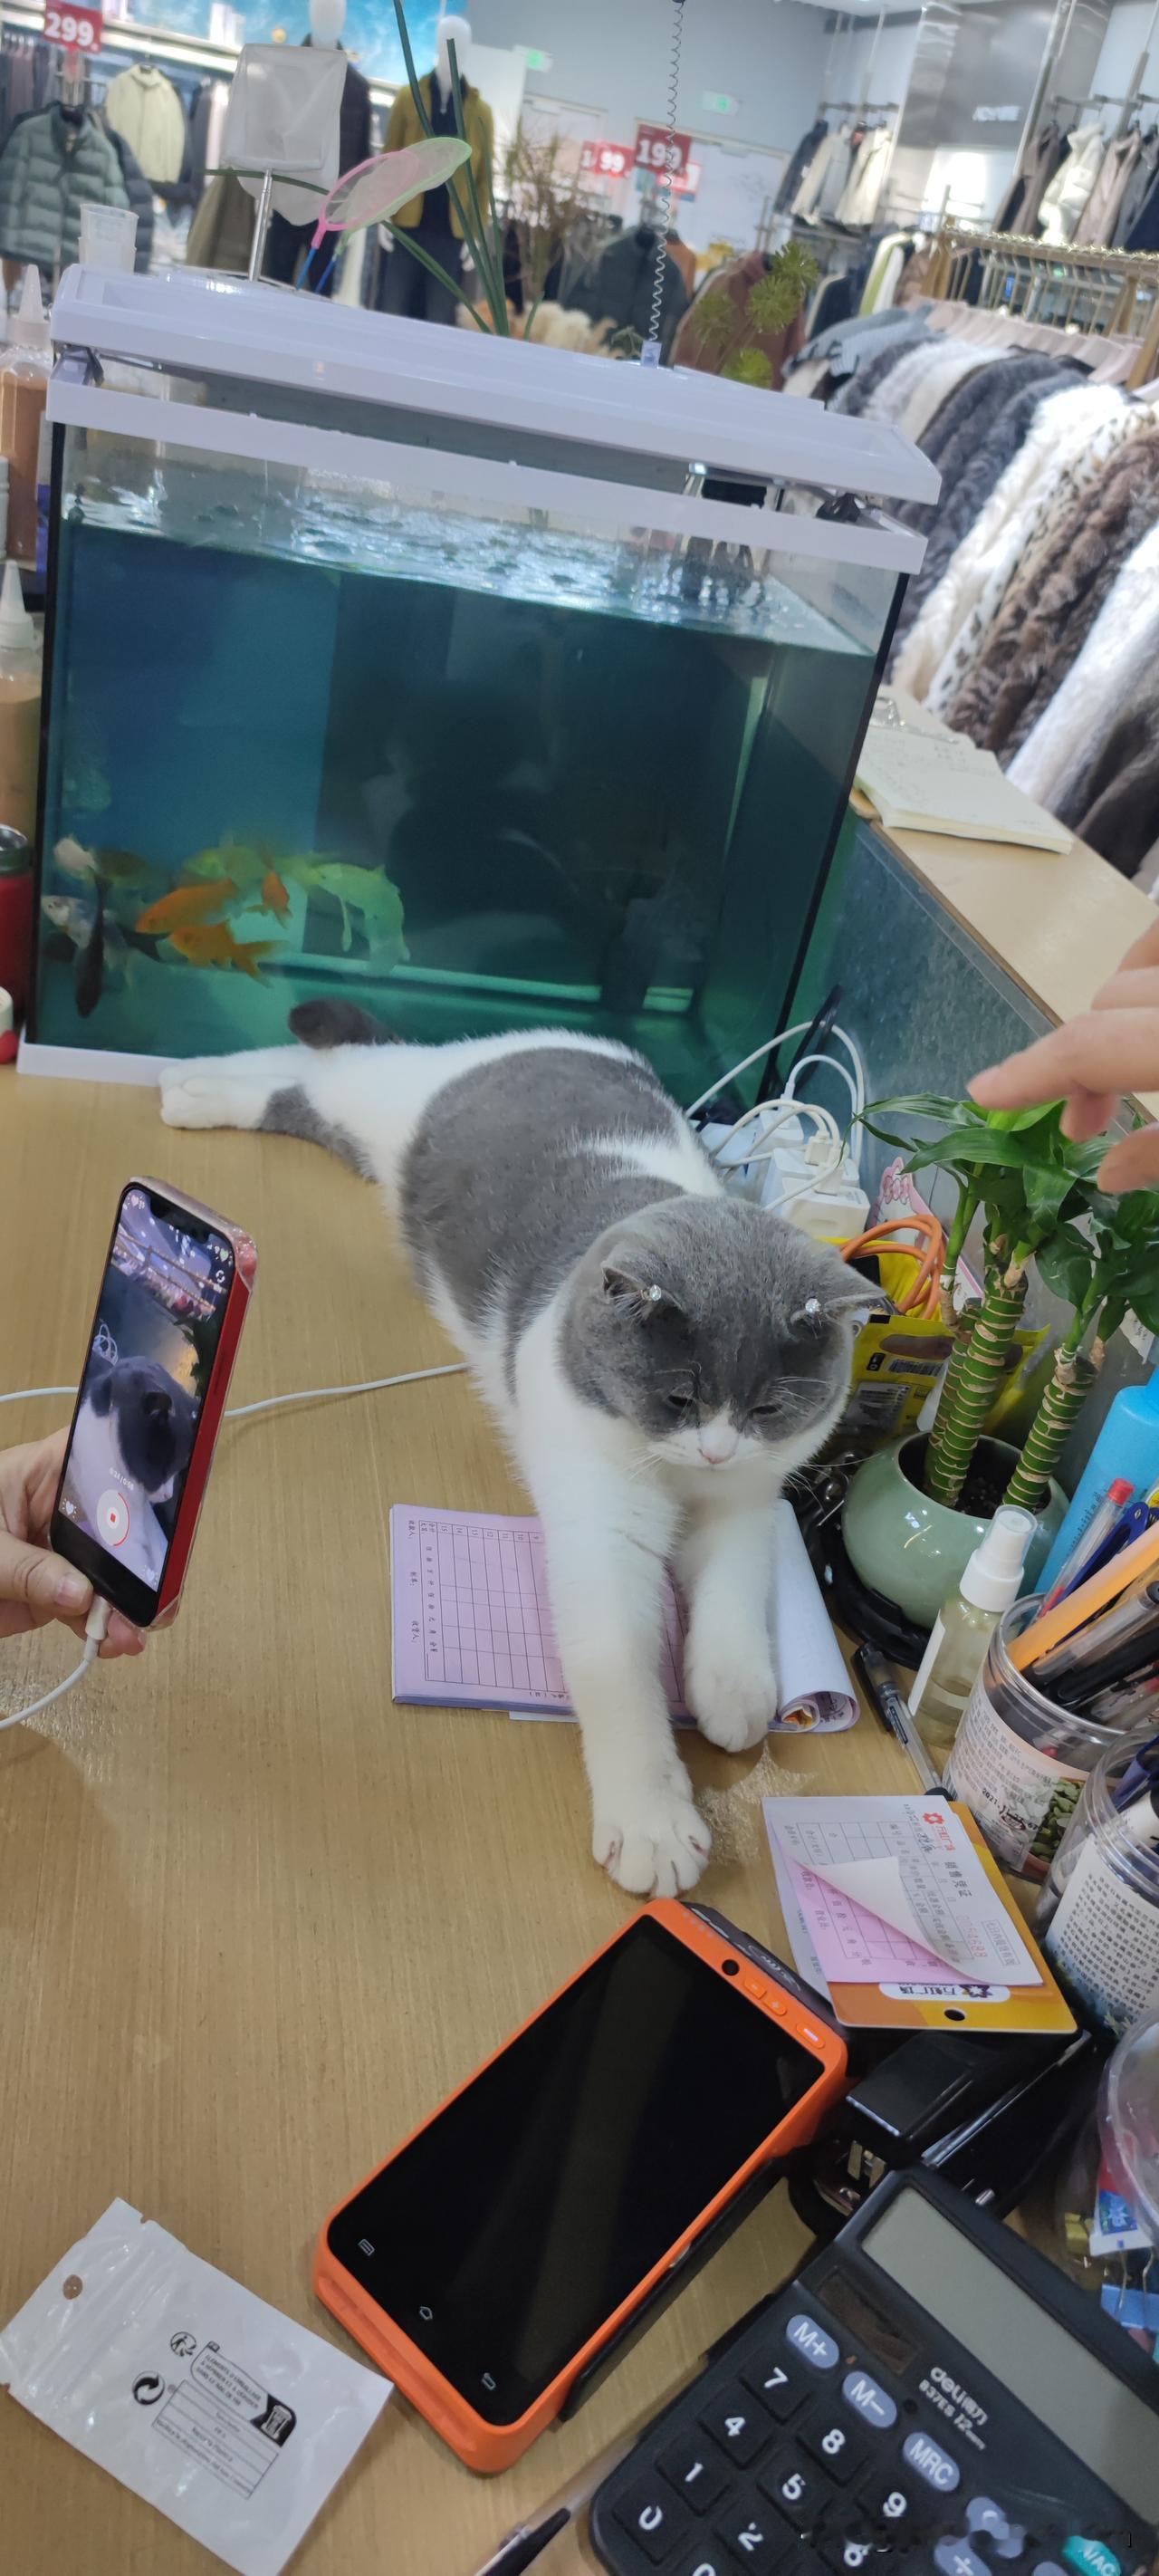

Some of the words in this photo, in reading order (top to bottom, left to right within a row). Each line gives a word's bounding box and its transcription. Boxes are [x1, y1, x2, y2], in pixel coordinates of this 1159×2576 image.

[44, 12, 94, 46] 299
[636, 139, 682, 169] 199
[793, 2321, 827, 2356] M+
[764, 2367, 789, 2388] 7
[851, 2379, 885, 2416] M-
[724, 2417, 746, 2437] 4
[822, 2428, 846, 2455] 8
[685, 2462, 704, 2483] 1
[909, 2438, 953, 2485] MRC
[781, 2473, 806, 2500] 5
[882, 2491, 907, 2518] 9
